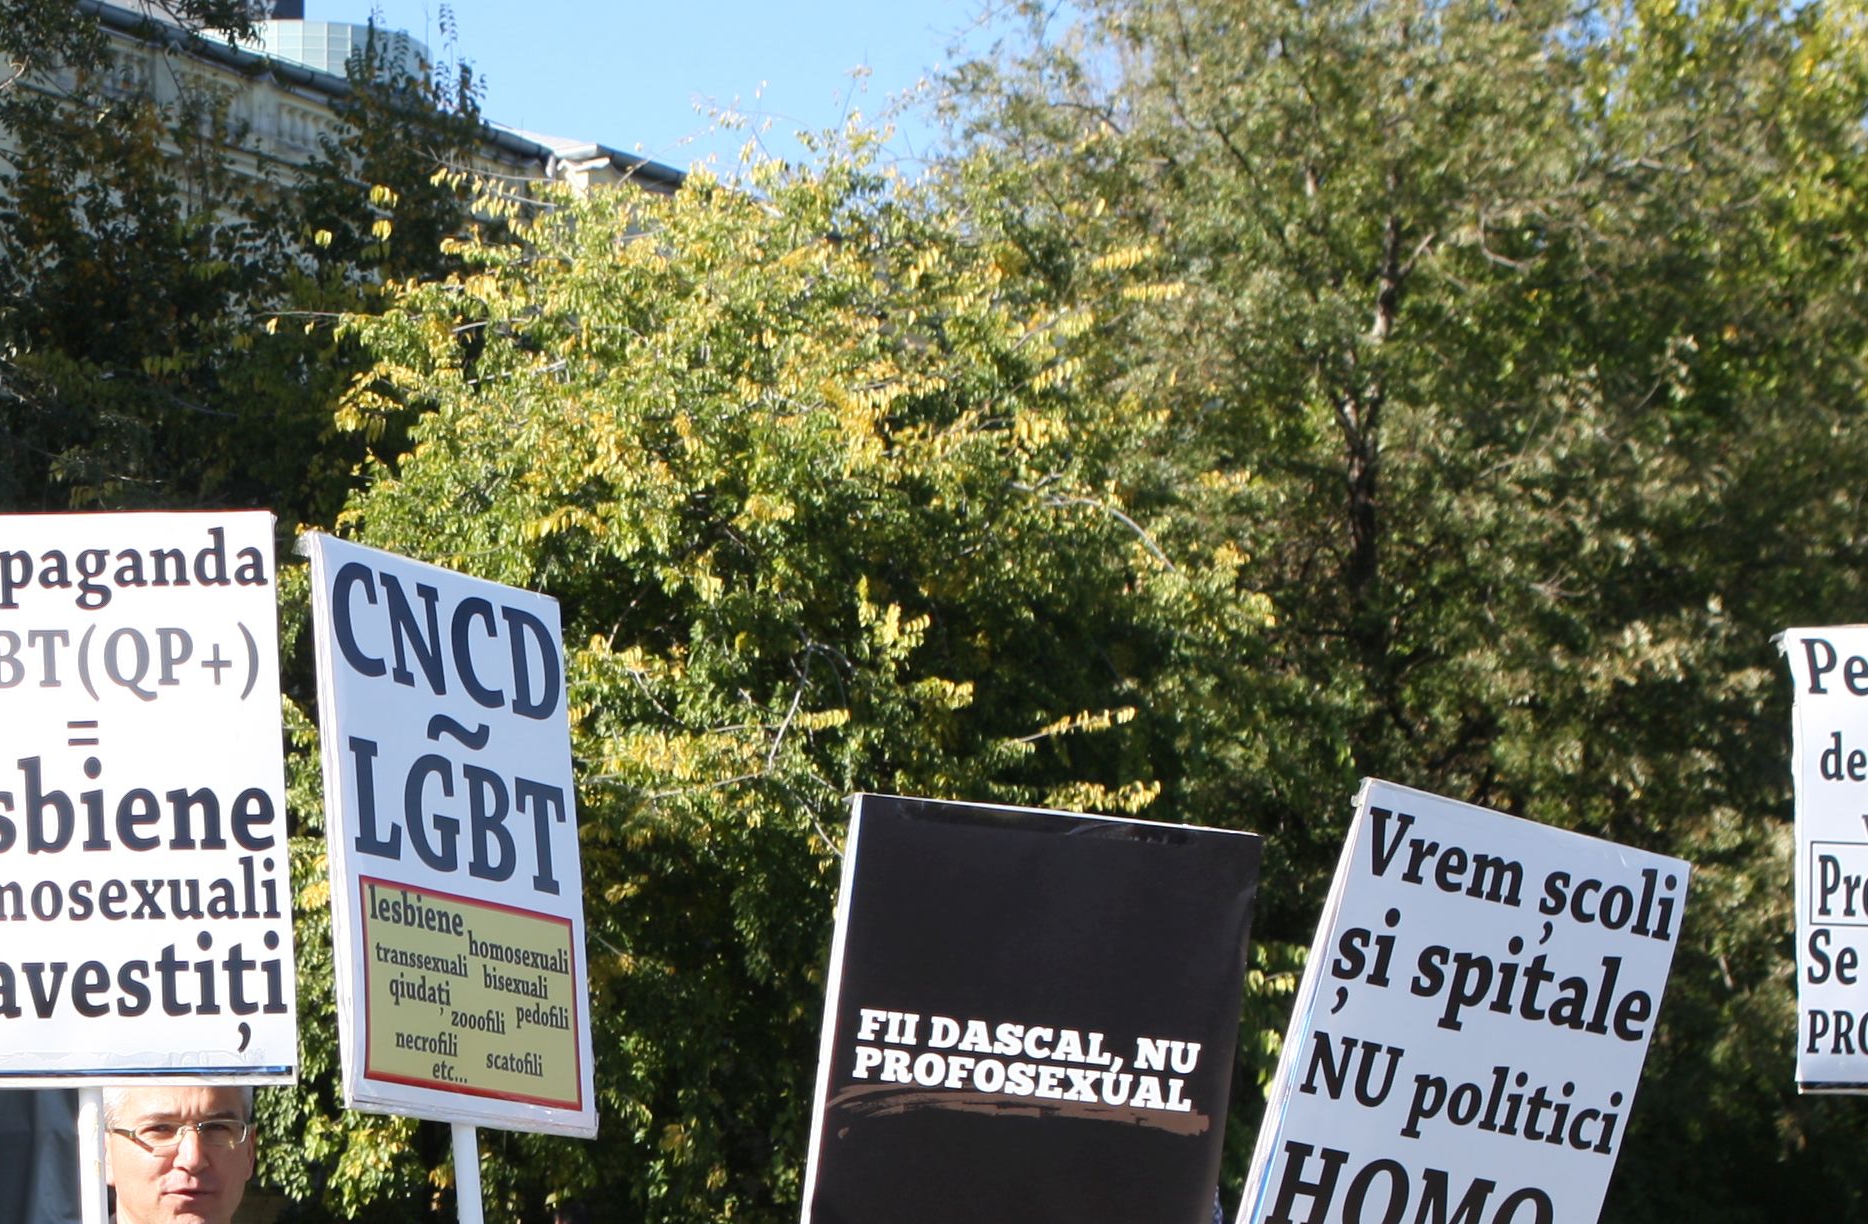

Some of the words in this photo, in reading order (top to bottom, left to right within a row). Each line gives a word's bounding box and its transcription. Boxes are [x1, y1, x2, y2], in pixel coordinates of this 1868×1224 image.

[333, 559, 560, 720] CNCD
[1801, 639, 1868, 696] Pe
[67, 721, 99, 746] =
[1821, 732, 1867, 781] de
[349, 736, 566, 895] LGBT
[1370, 807, 1523, 907] Vrem
[1539, 869, 1677, 944] școli
[1819, 855, 1868, 916] Pr
[368, 884, 463, 936] lesbiene
[376, 942, 468, 978] transsexuali
[468, 930, 569, 975] homosexuali
[1331, 908, 1400, 1014] și
[1411, 936, 1651, 1041] spitale
[1808, 929, 1858, 985] Se
[390, 972, 451, 1015] qiudați
[483, 964, 548, 1000] bisexuali
[451, 1010, 505, 1035] zooofili
[516, 1003, 569, 1030] pedofili
[858, 1009, 919, 1045] FII
[928, 1016, 1123, 1072] DASCAL,
[1134, 1038, 1201, 1073] NU
[396, 1032, 457, 1057] necrofili
[486, 1052, 543, 1077] scatofili
[433, 1061, 467, 1083] etc...
[853, 1046, 1191, 1111] PROFOSEXUAL
[1300, 1031, 1404, 1107] NU
[1400, 1066, 1622, 1154] politici
